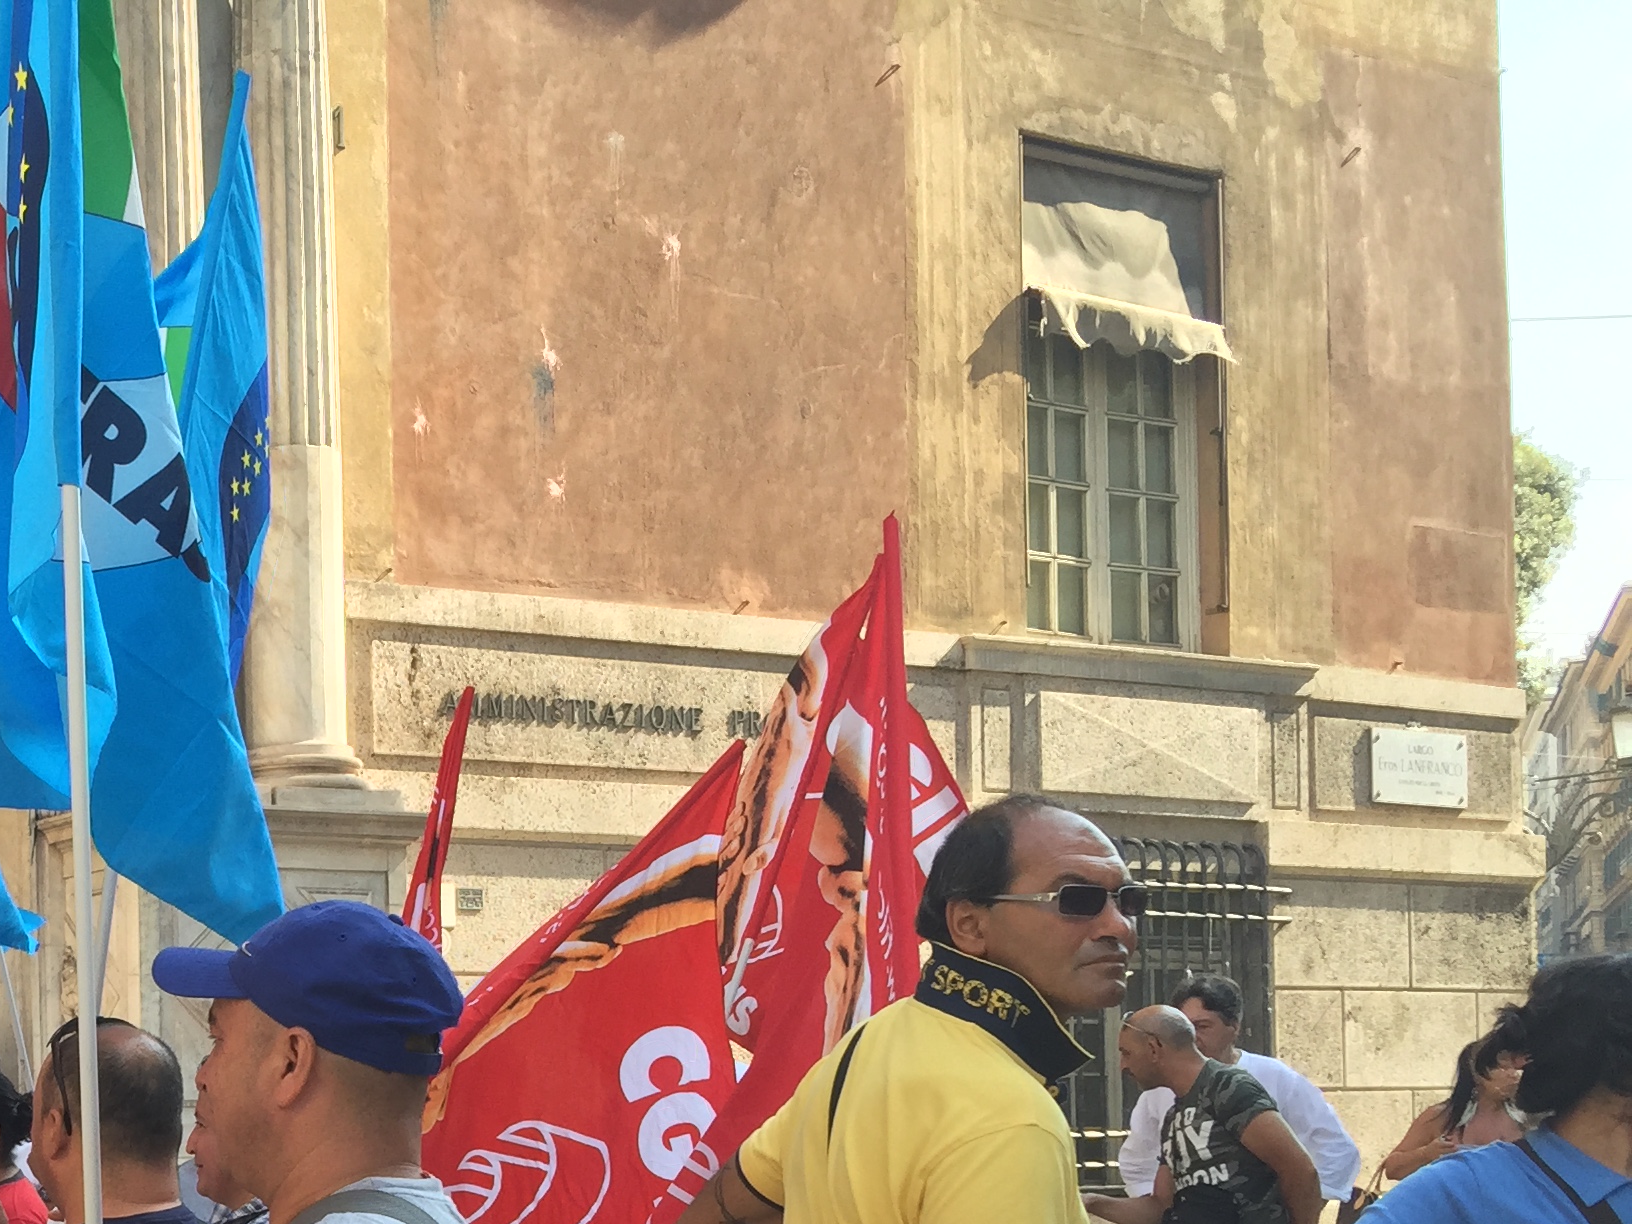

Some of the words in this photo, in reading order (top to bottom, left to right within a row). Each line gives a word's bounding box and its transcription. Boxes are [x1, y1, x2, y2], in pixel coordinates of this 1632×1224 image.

[1408, 744, 1434, 756] LARGO
[1378, 756, 1398, 772] Eros
[1401, 758, 1463, 777] LANFRANCO
[930, 963, 1031, 1029] SPORT
